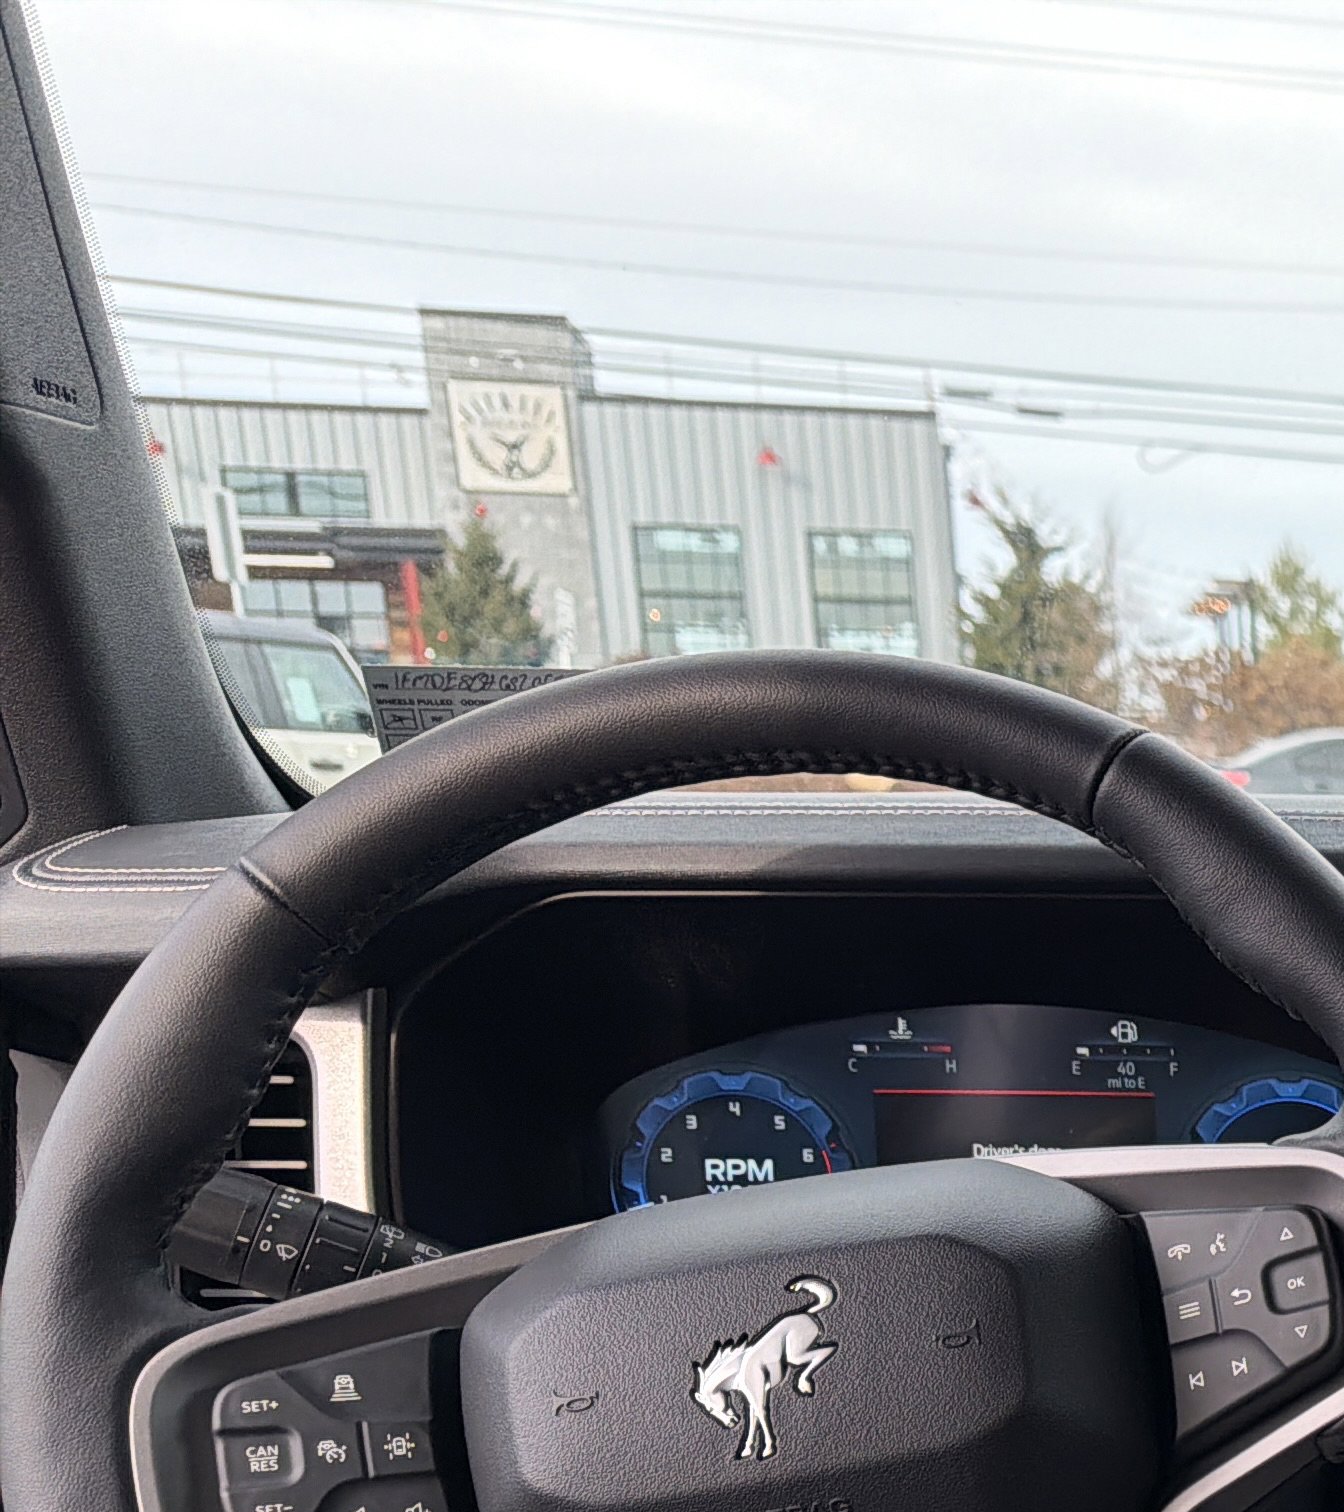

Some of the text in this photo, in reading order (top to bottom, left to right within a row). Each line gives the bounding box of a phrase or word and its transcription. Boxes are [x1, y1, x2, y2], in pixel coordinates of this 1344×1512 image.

[848, 1058, 858, 1072] C
[945, 1059, 957, 1073] H
[1071, 1061, 1081, 1075] E
[1117, 1062, 1135, 1076] 40
[1169, 1062, 1179, 1077] F
[1107, 1077, 1146, 1089] mi to E
[728, 1101, 741, 1117] 4
[686, 1115, 698, 1130] 3
[774, 1115, 786, 1130] 5
[660, 1147, 673, 1163] 2
[802, 1148, 814, 1163] 6
[704, 1158, 775, 1182] RPM
[1287, 1276, 1306, 1289] OK
[241, 1399, 279, 1414] SET+
[245, 1445, 279, 1458] CAN
[250, 1460, 279, 1473] RES
